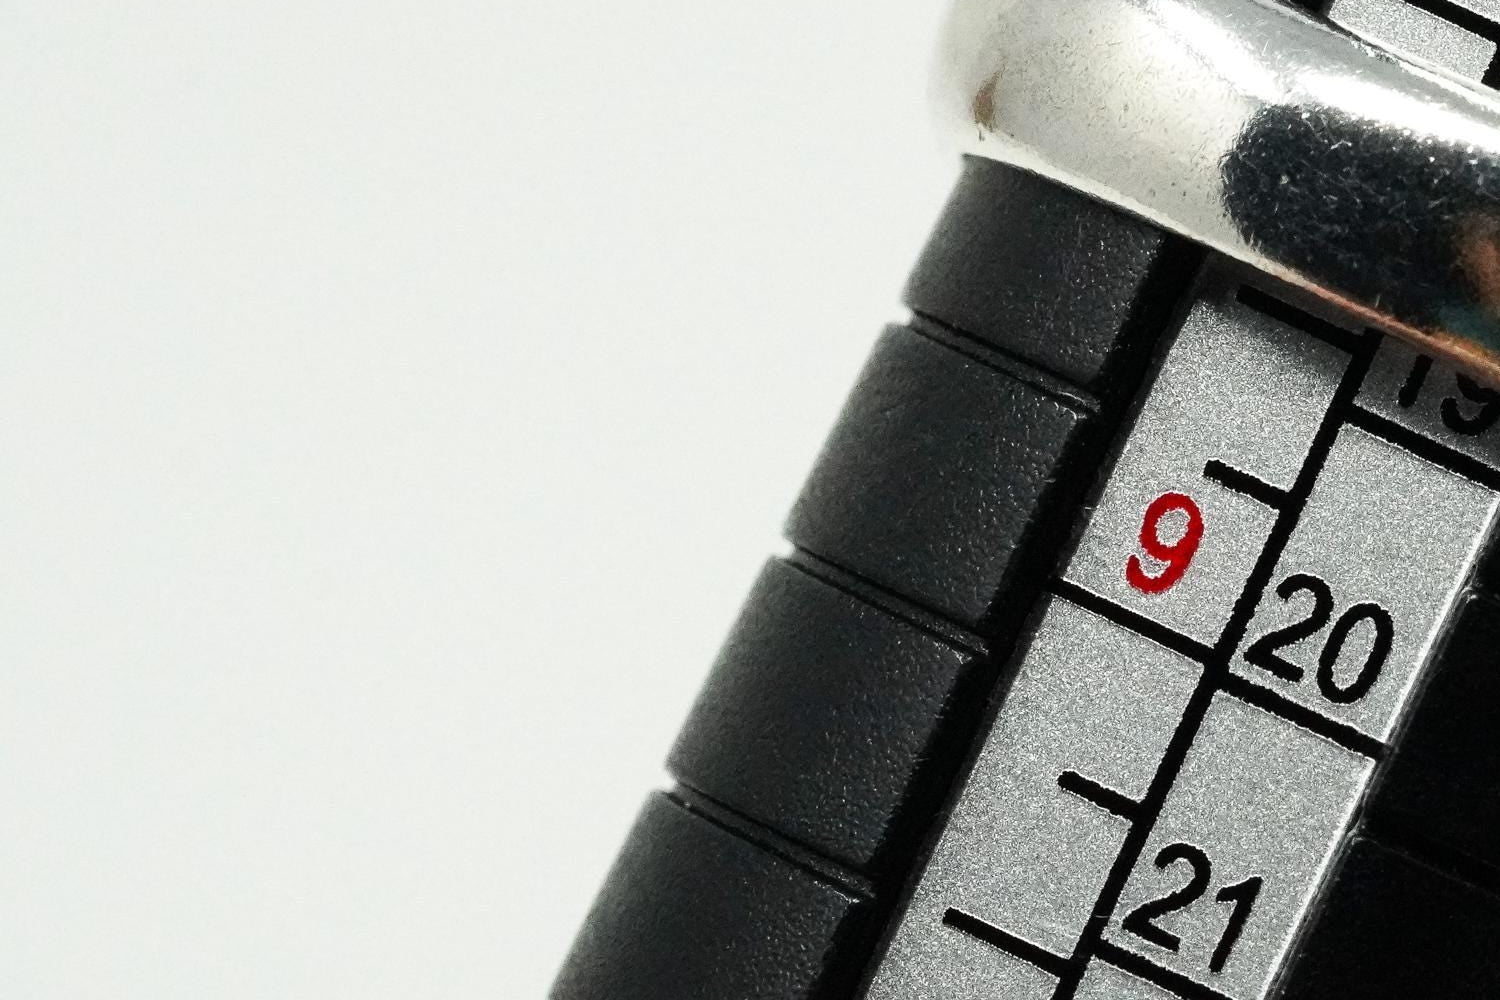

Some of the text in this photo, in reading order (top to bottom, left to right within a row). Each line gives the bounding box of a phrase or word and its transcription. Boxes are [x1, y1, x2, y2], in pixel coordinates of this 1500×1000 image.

[1125, 492, 1205, 594] 9
[1243, 573, 1394, 704] 20
[1121, 842, 1263, 974] 21
